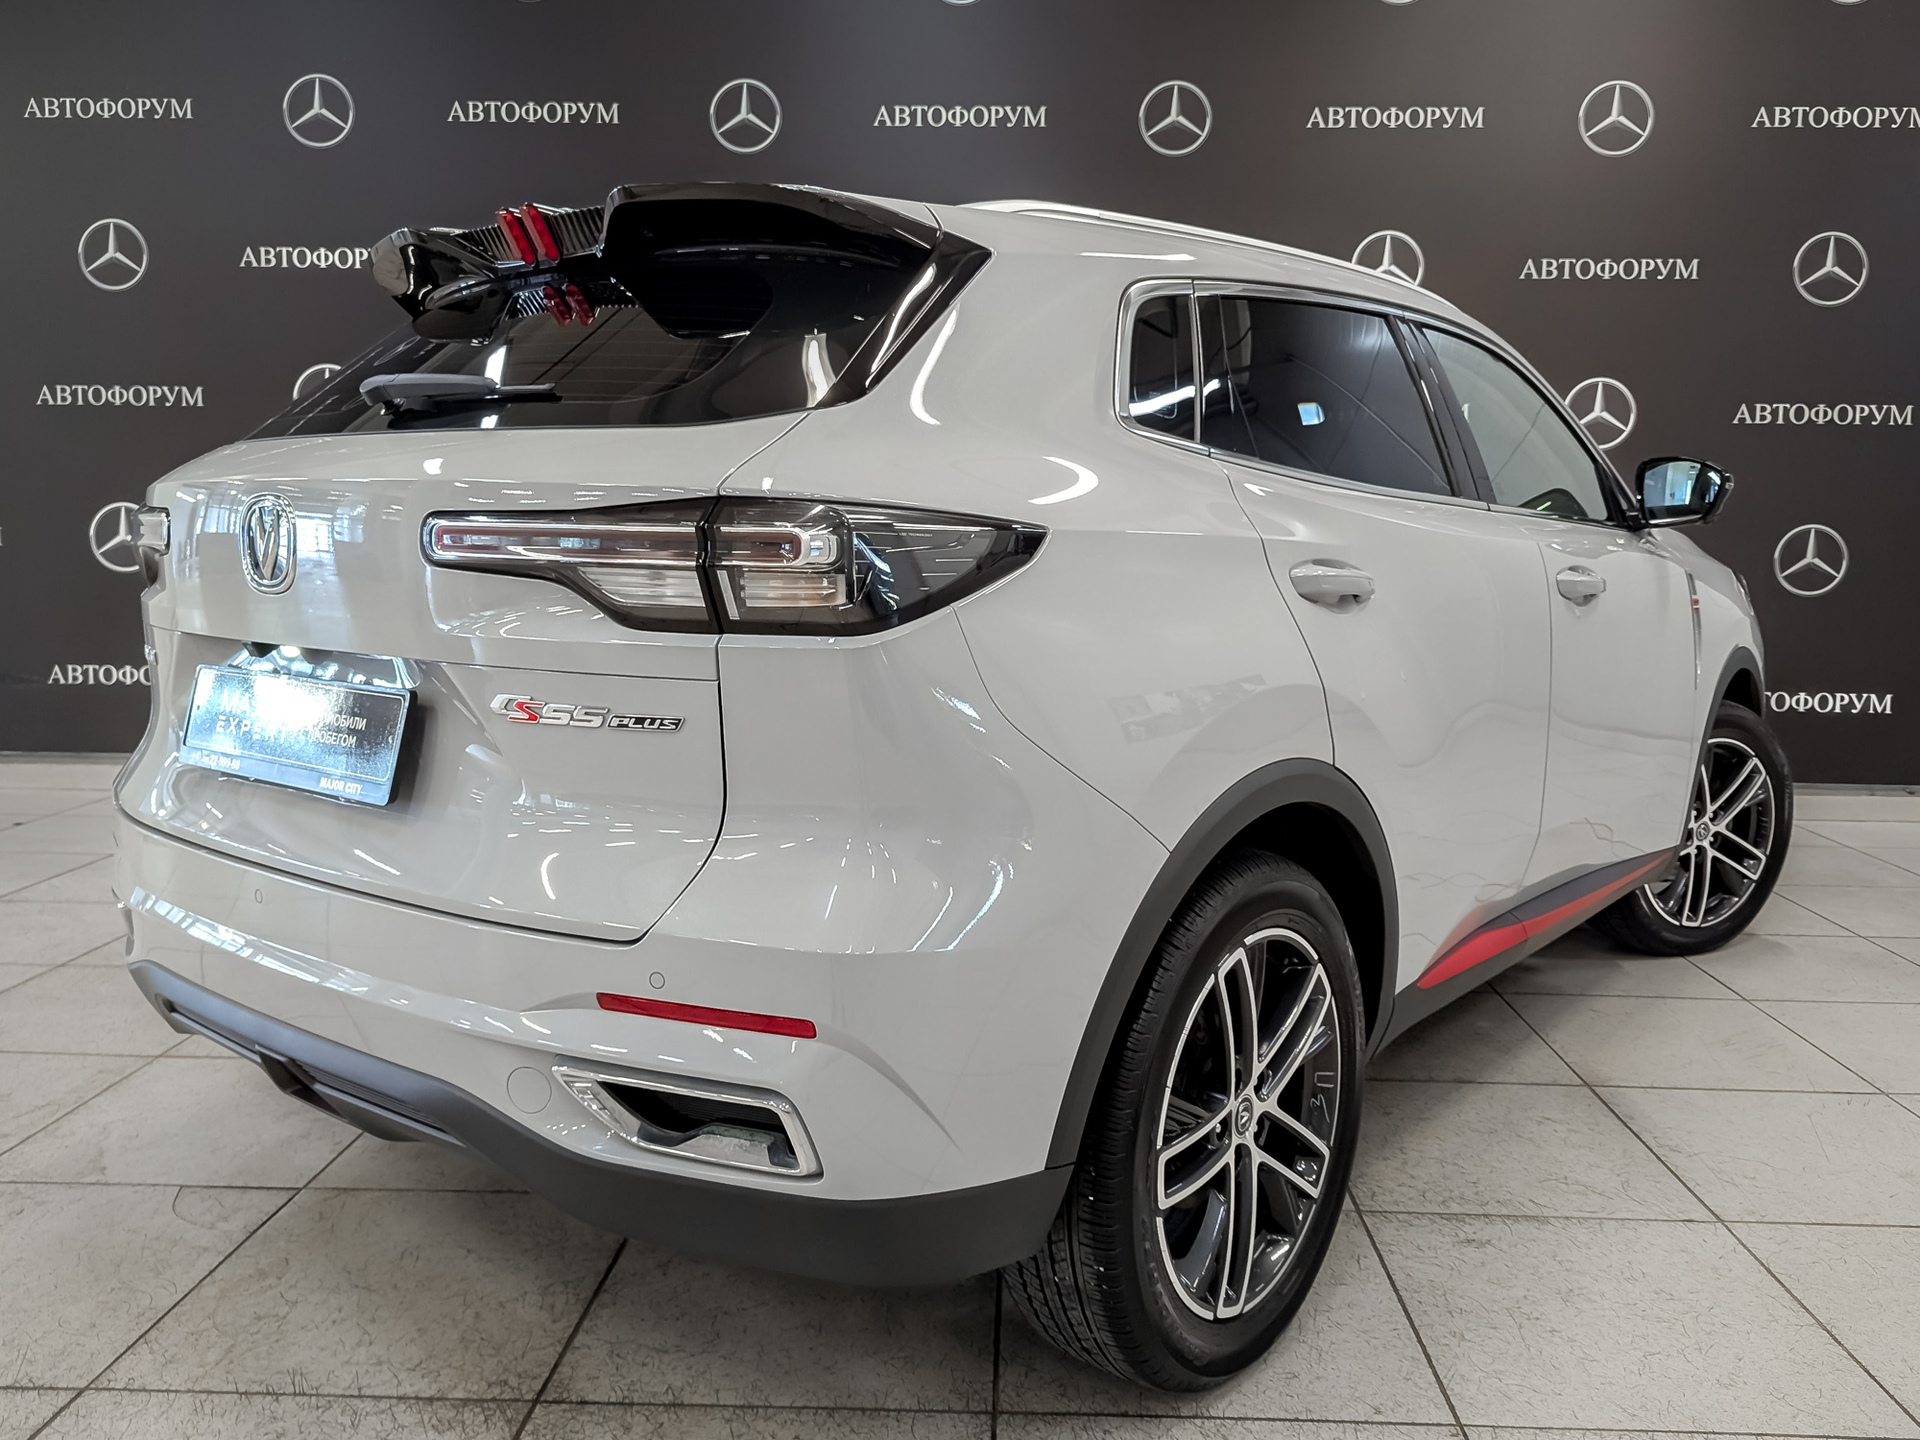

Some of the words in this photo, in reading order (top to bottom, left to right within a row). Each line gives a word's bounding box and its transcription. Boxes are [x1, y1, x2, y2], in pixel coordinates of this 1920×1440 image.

[23, 97, 194, 120] АВТОФОРУМ
[446, 100, 619, 124] АВТОФОРУМ
[872, 104, 1047, 128] АВТОФОРУМ
[1305, 106, 1486, 129] АВТОФОРУМ
[239, 246, 371, 270] АВТОФОР
[1518, 257, 1700, 280] АВТОФОРУМ
[35, 384, 204, 407] АВТОФОРУМ
[1732, 403, 1914, 426] АВТОФОРУМ
[608, 714, 682, 732] PLUS
[319, 776, 345, 792] MAJOR
[345, 781, 363, 795] CITY
